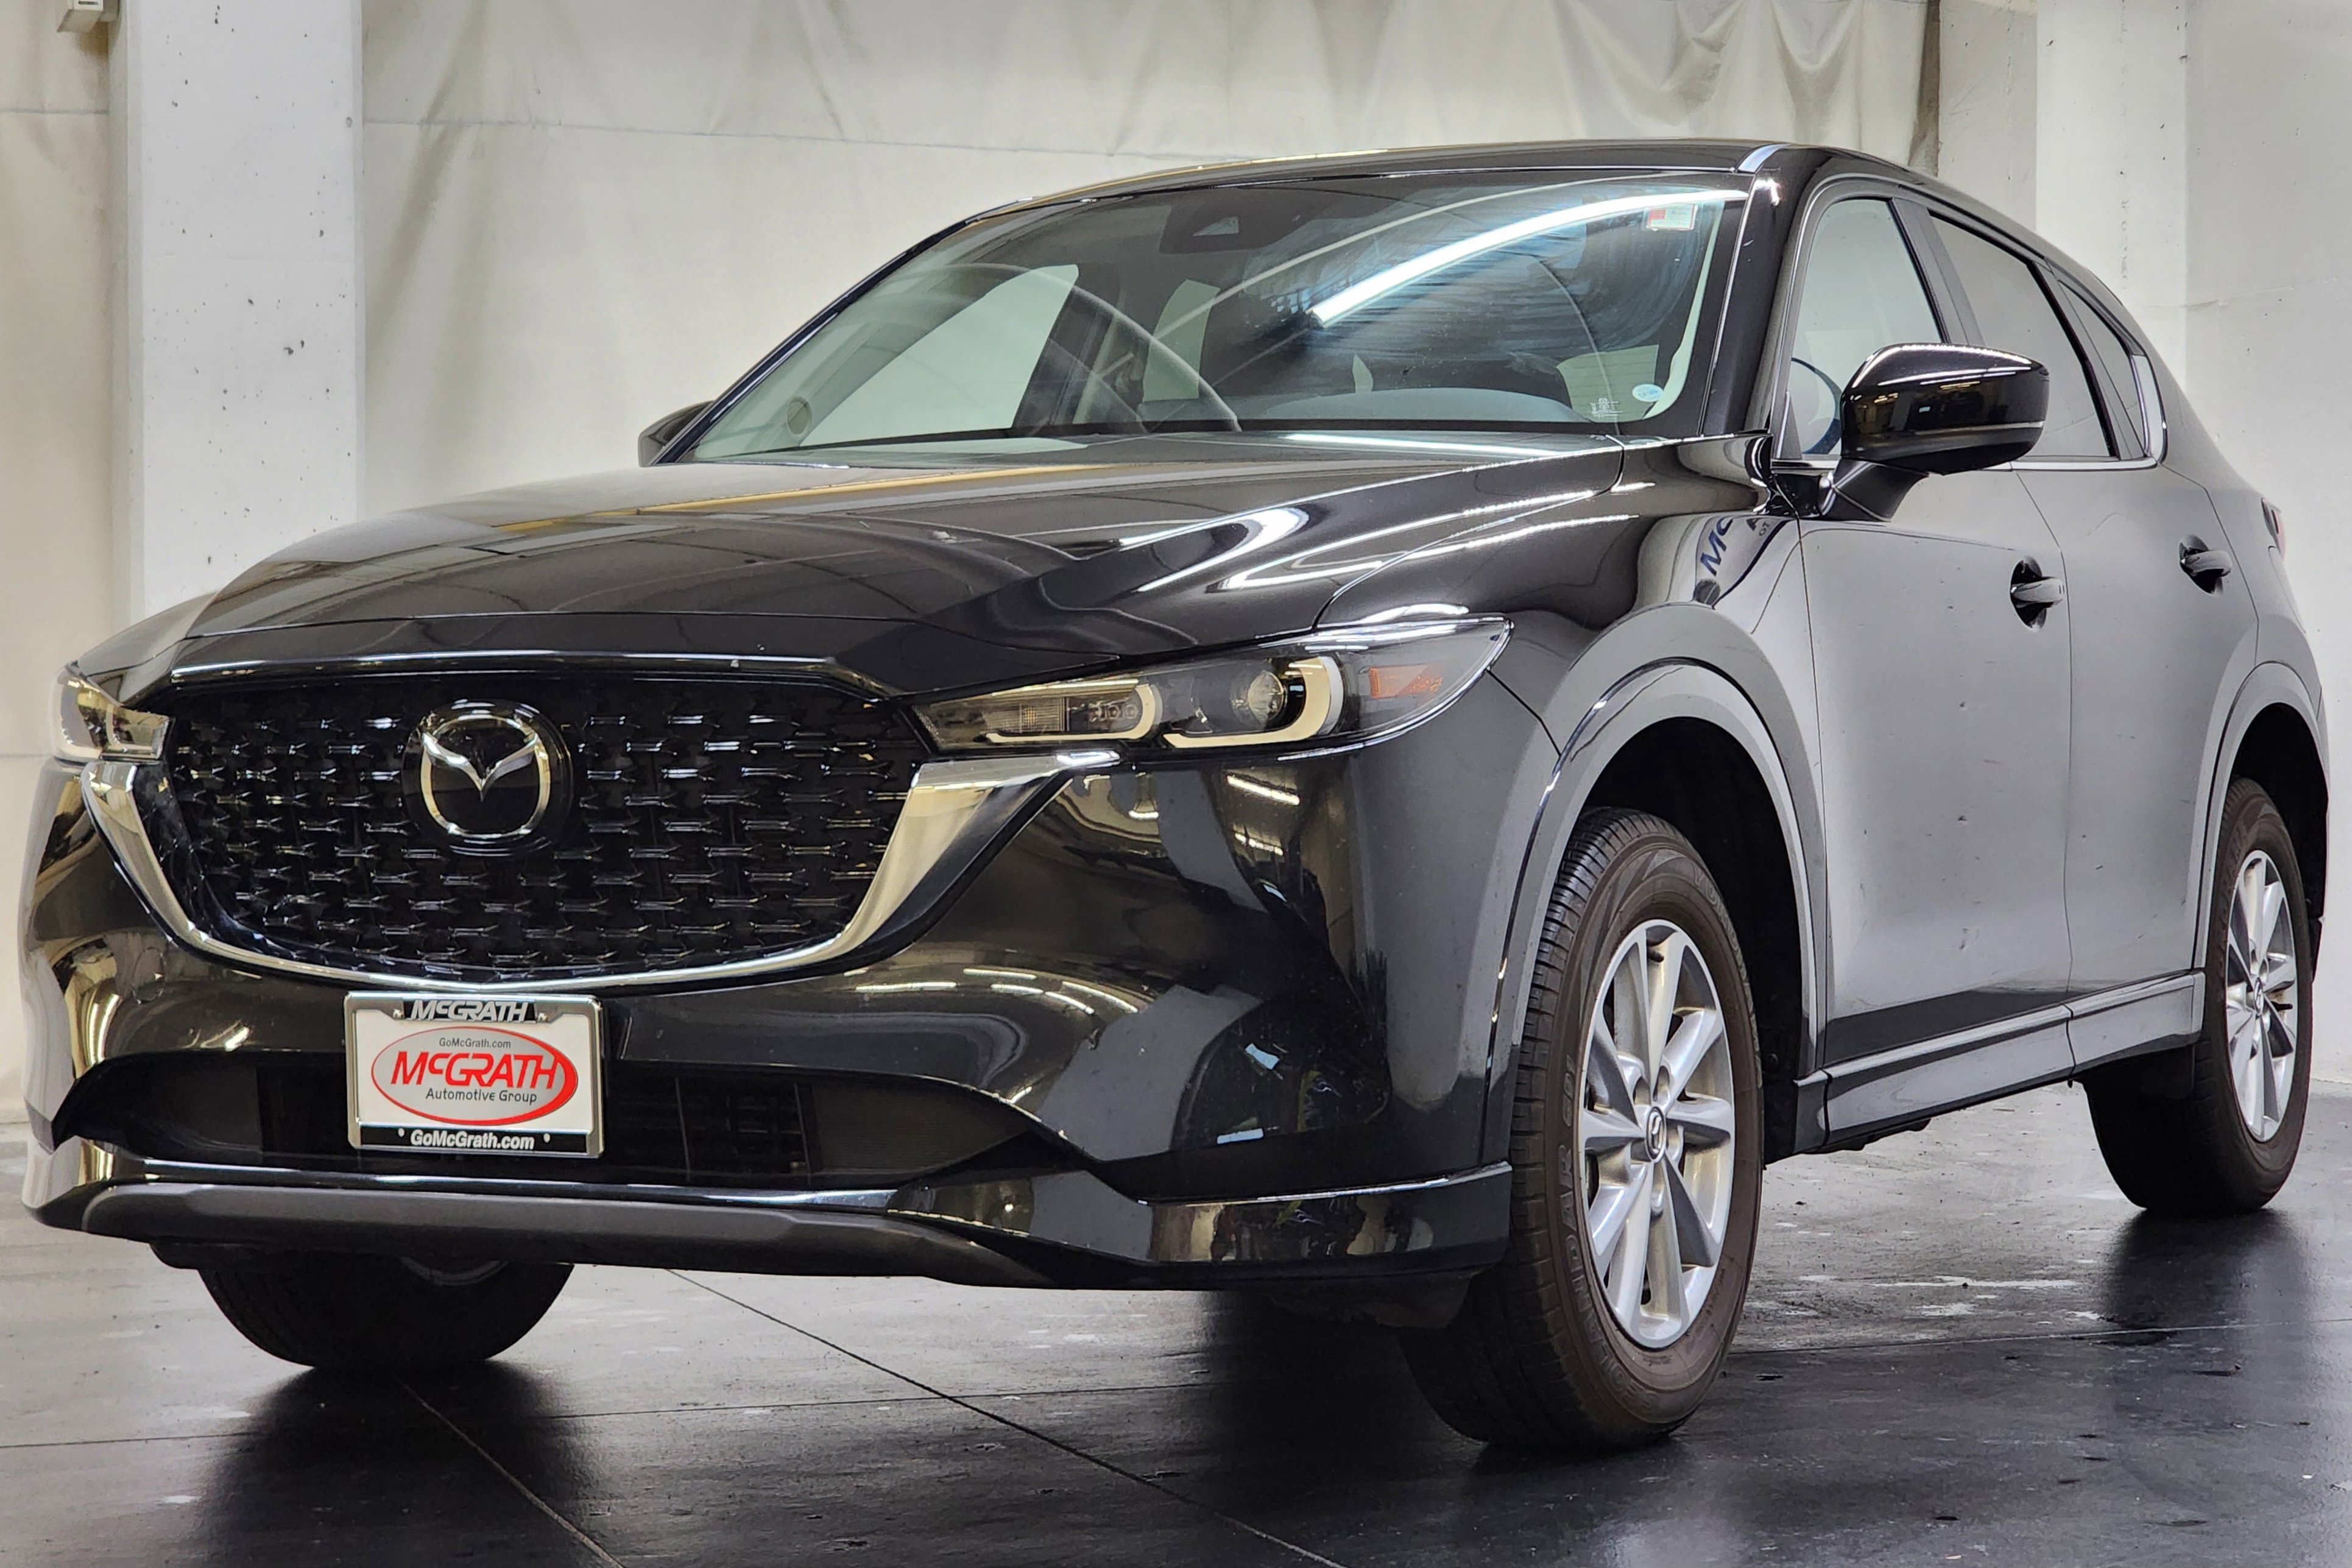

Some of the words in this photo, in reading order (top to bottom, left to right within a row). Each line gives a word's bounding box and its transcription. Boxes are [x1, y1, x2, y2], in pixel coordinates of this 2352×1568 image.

[439, 1037, 511, 1049] GoMcGrath.com
[425, 1087, 496, 1101] Automotive
[499, 1089, 537, 1106] Group
[410, 1129, 534, 1150] GoMcGrath.com
